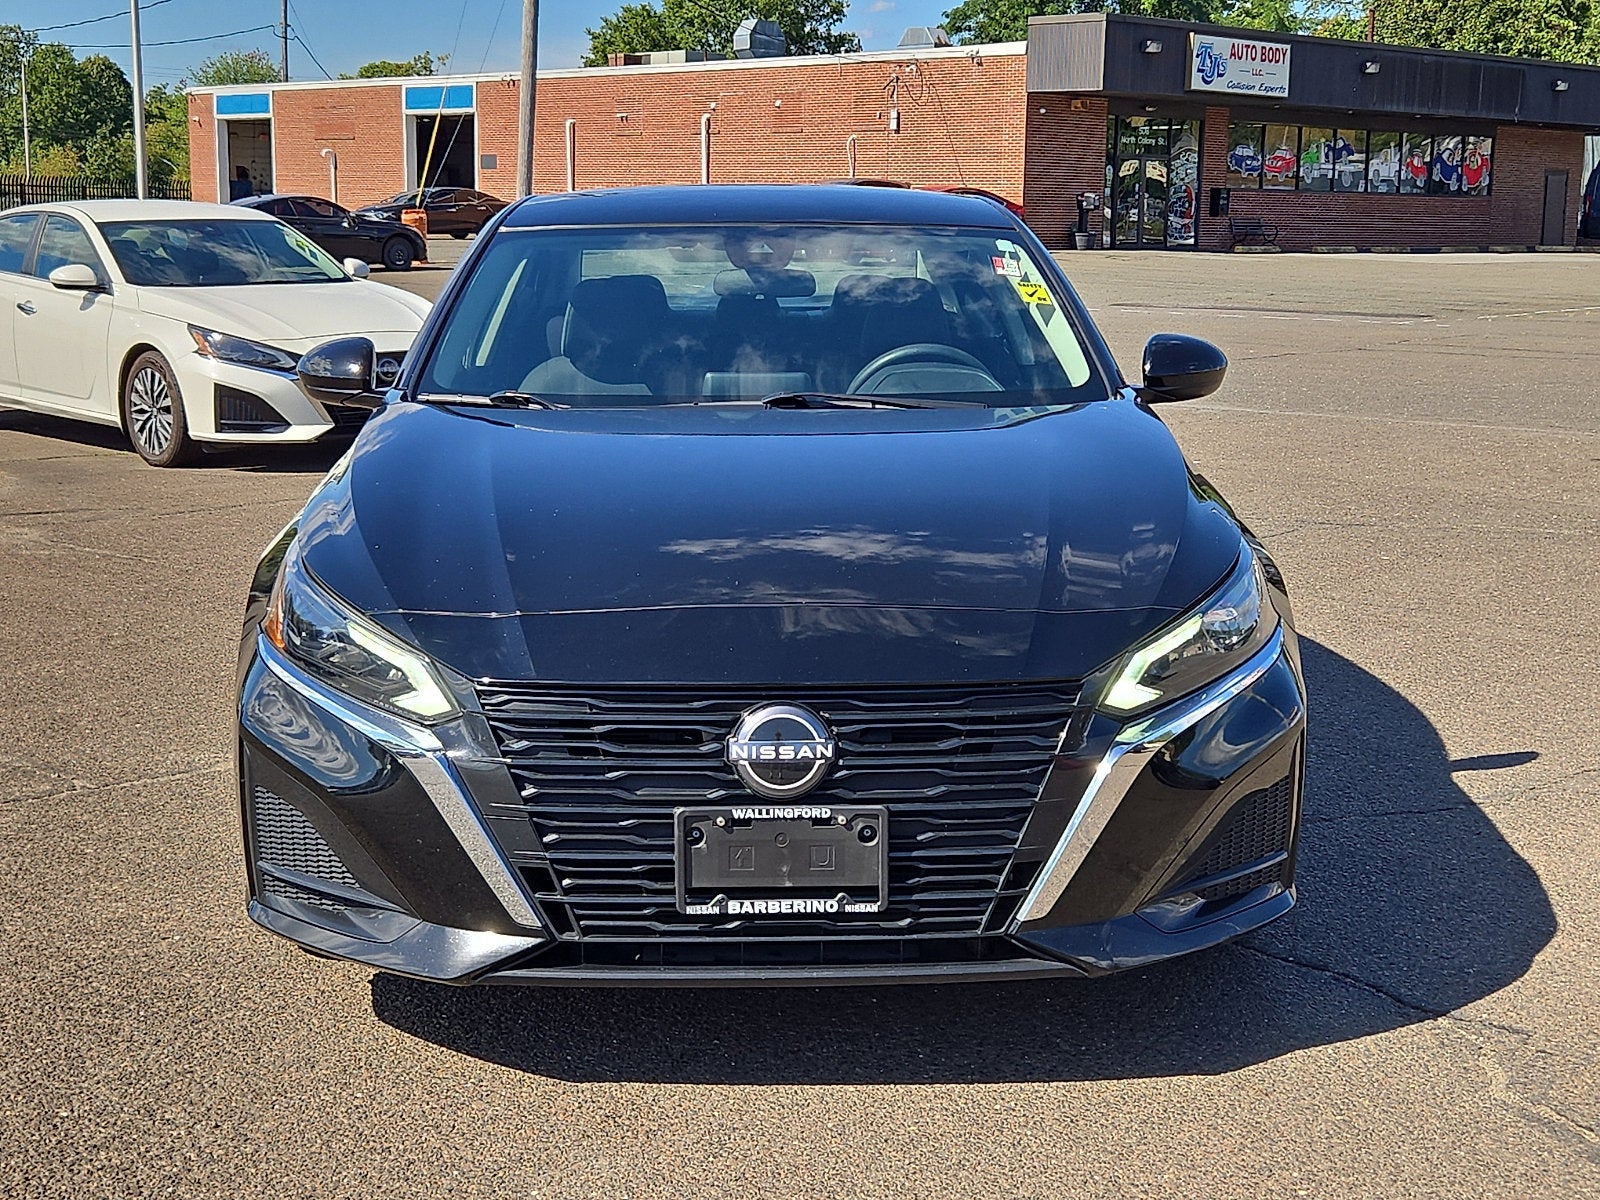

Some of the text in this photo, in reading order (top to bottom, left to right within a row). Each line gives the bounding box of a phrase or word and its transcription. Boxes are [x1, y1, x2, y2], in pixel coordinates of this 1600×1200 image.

[1229, 42, 1288, 65] AUTO BODY
[1226, 80, 1287, 94] Collision Experts
[1120, 135, 1136, 144] North
[1137, 136, 1156, 146] Colony
[731, 743, 833, 760] NISSAN
[731, 807, 832, 819] WALLINGFORD
[686, 905, 720, 915] NISSAN
[727, 900, 839, 914] BARBERINO
[844, 904, 879, 913] NISSAN
